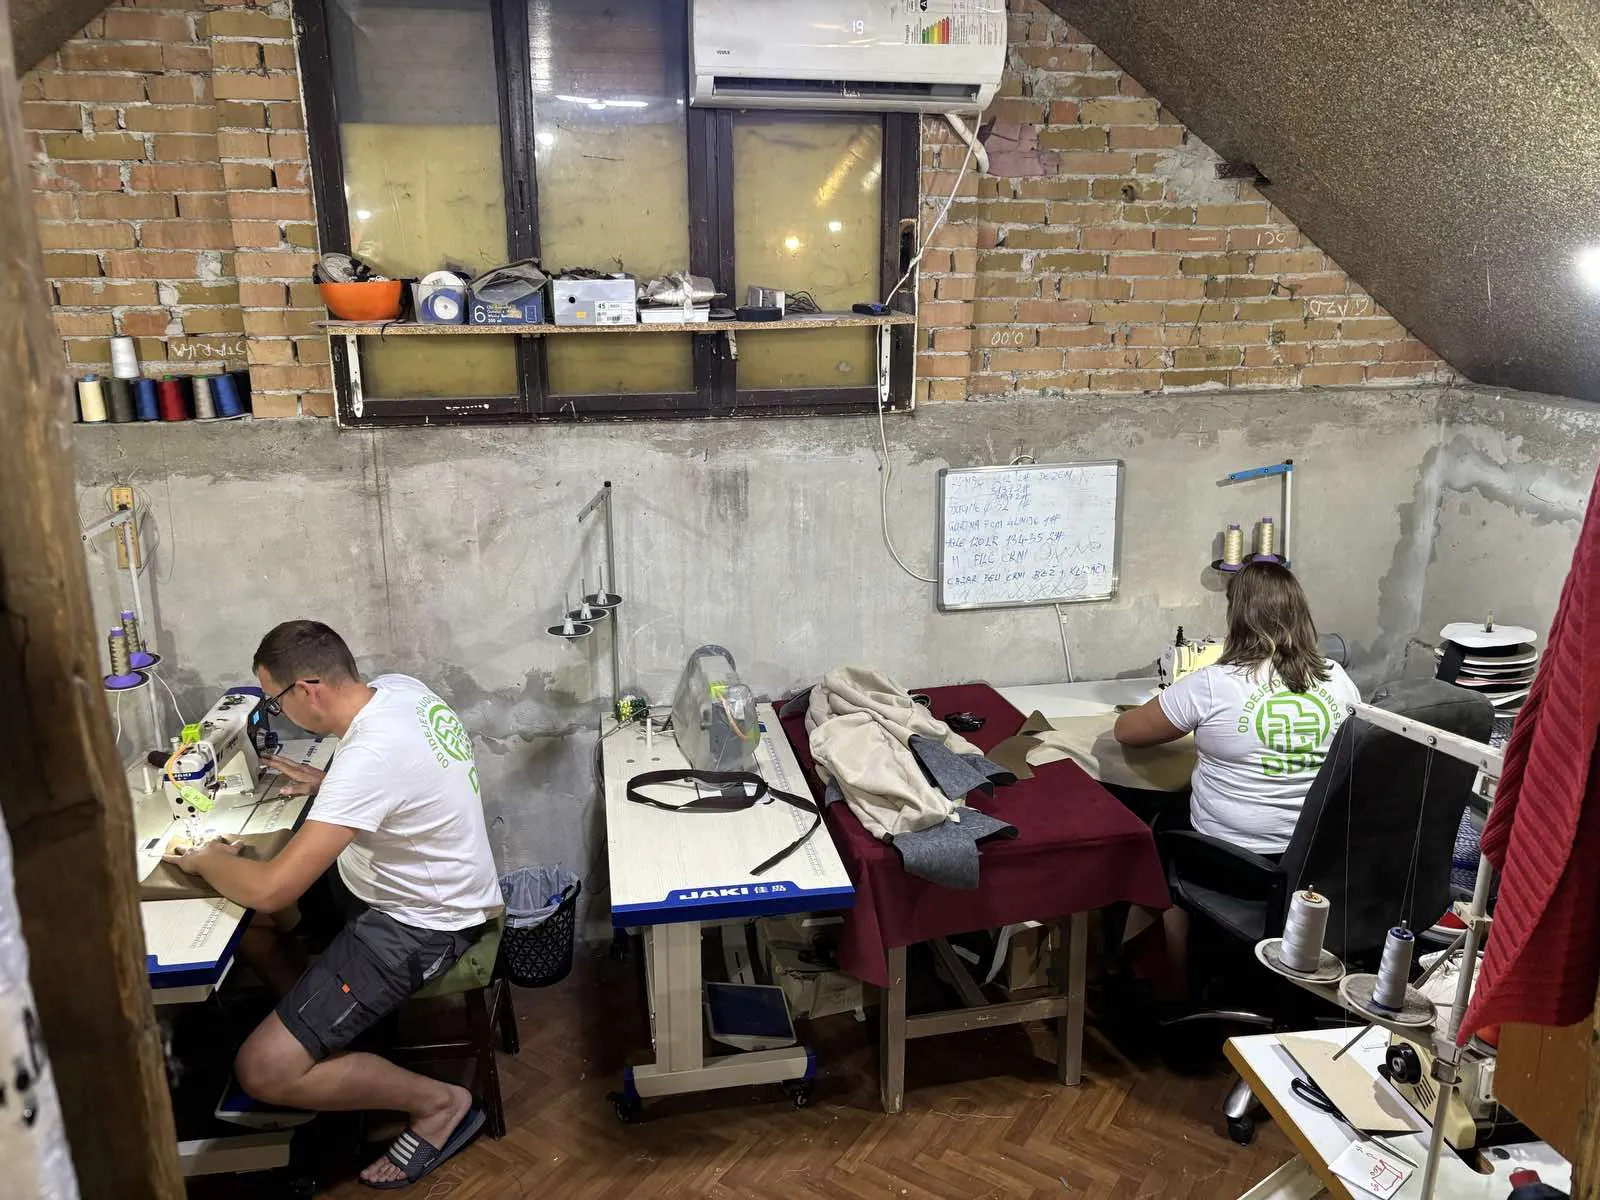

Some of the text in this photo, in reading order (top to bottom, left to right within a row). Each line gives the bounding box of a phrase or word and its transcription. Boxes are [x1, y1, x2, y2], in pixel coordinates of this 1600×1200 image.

[852, 20, 864, 34] 19
[474, 305, 486, 323] 6
[1243, 682, 1271, 714] IDEJE
[1238, 714, 1249, 734] OD
[679, 887, 749, 900] JAKI
